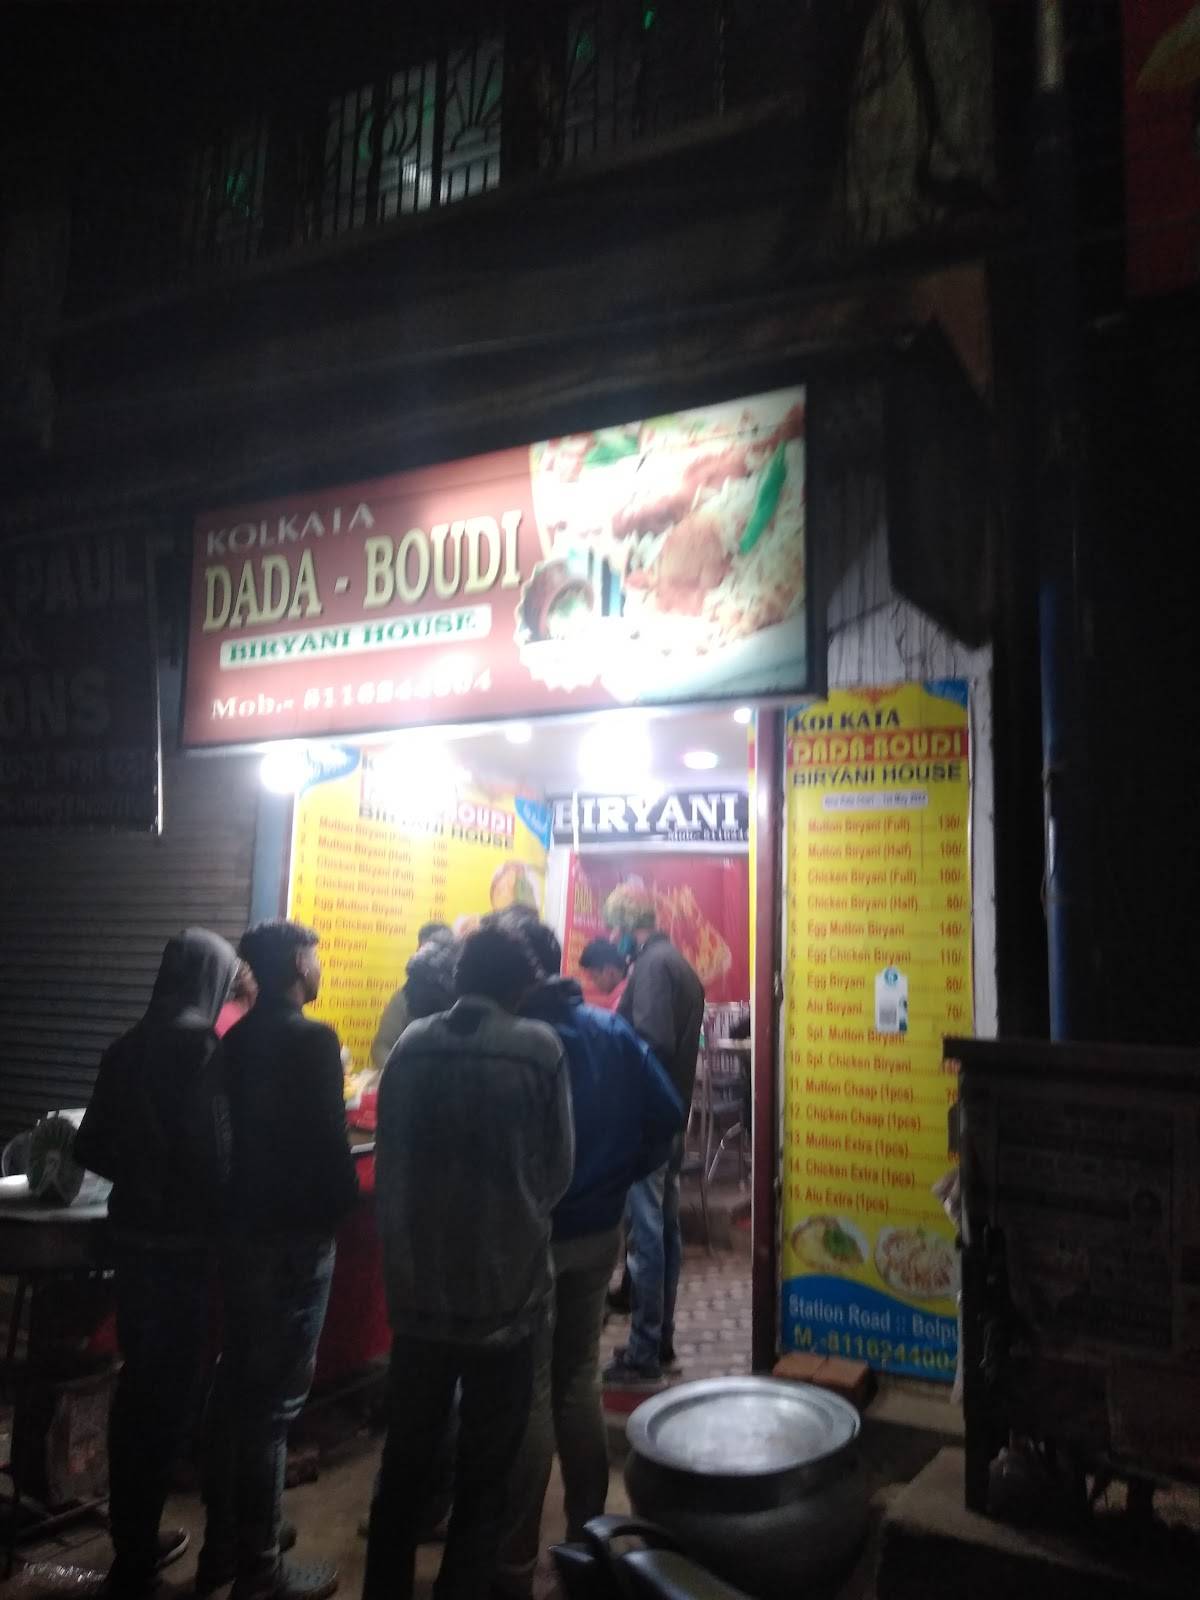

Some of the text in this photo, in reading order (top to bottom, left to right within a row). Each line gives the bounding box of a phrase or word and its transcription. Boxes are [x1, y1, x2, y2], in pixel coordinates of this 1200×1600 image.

[207, 502, 376, 556] KOLKATA
[202, 548, 322, 633] DADA
[363, 509, 522, 609] BOUDI
[229, 608, 478, 662] BIRYANI HOUSE
[792, 709, 901, 733] KOLKATA
[792, 731, 962, 766] DADA-BOUDI
[792, 763, 962, 787] BIRYANI HOUSE
[808, 817, 842, 833] Mutton
[845, 817, 880, 835] Biryani
[451, 823, 515, 850] HOUSE
[808, 843, 842, 859] Mutton
[845, 843, 880, 861] Biryani
[808, 869, 848, 884] Chicken
[851, 869, 887, 886] Biryani
[808, 895, 848, 910] Chicken
[851, 896, 887, 912] Biryani
[808, 920, 827, 937] Egg
[830, 921, 865, 937] Mutton
[867, 922, 905, 940] Biryani
[808, 947, 827, 963] Egg
[830, 947, 871, 962] Chicken
[874, 948, 911, 966] Biryani
[808, 973, 827, 990] Egg
[830, 974, 865, 990] Biryani
[807, 998, 823, 1013] Alu
[826, 999, 863, 1016] Biryani
[829, 1026, 865, 1041] Mutton
[867, 1027, 905, 1045] Biryani
[829, 1053, 870, 1070] Chicken
[873, 1055, 912, 1074] Biryani
[805, 1078, 841, 1096] Mutton
[806, 1103, 848, 1122] Chicken
[805, 1133, 842, 1150] Mutton
[844, 1135, 873, 1152] Extra
[805, 1159, 848, 1178] Chicken
[851, 1161, 879, 1181] Extra
[804, 1184, 823, 1201] Alu
[826, 1187, 854, 1206] Extra
[788, 1293, 844, 1325] Station
[849, 1303, 892, 1332] Road
